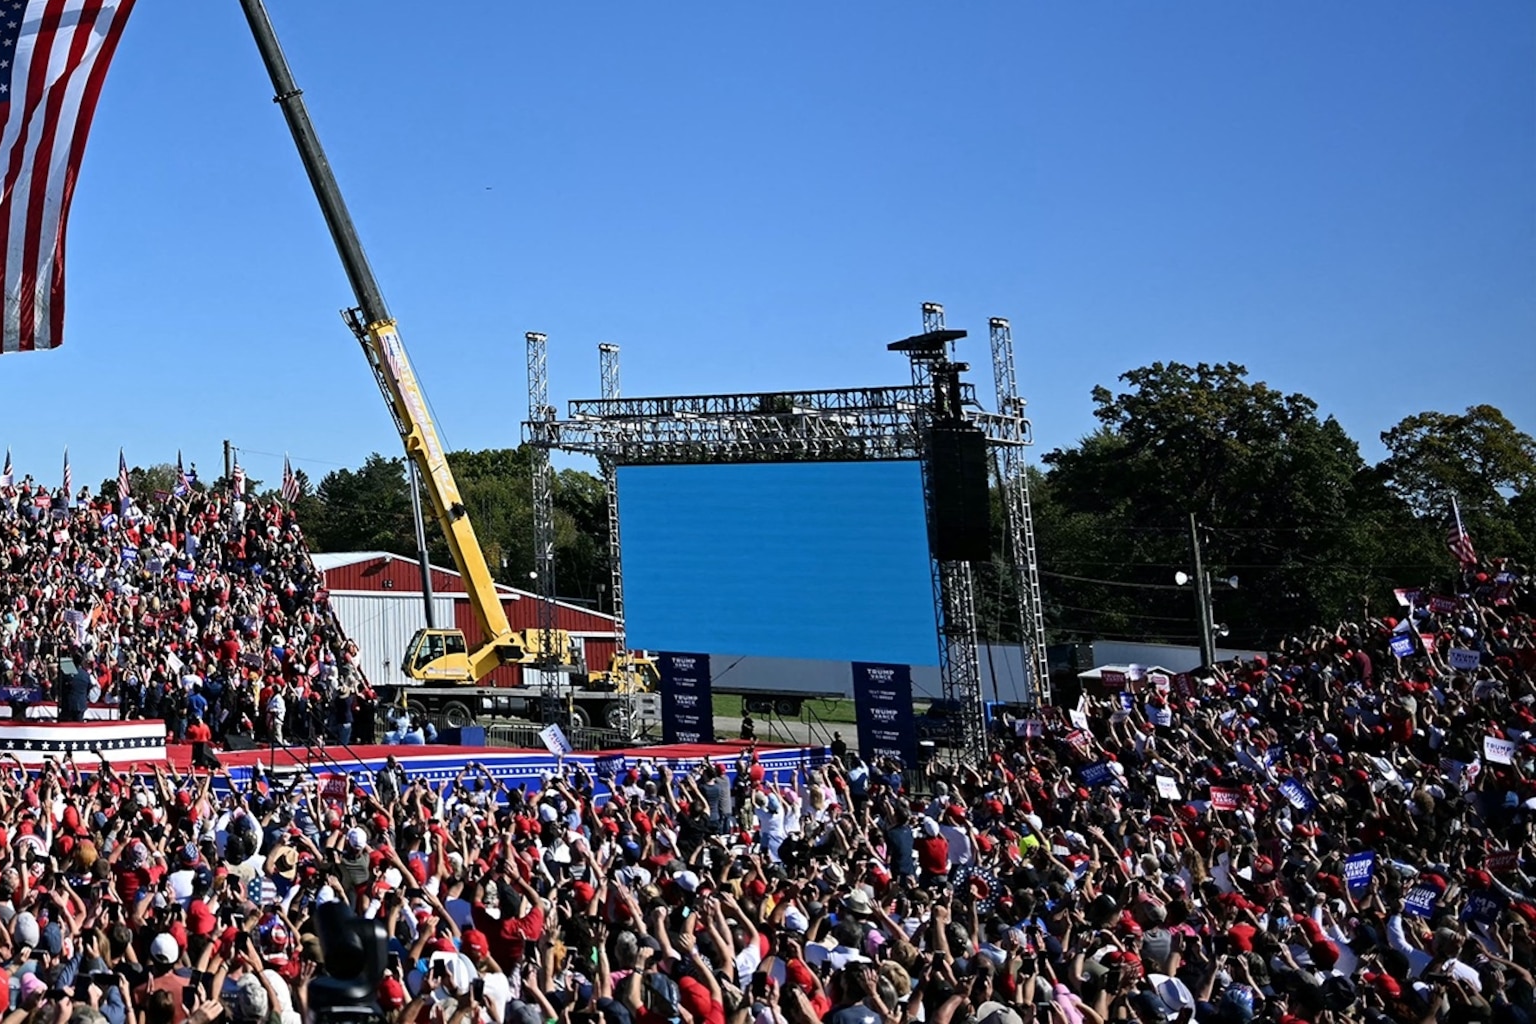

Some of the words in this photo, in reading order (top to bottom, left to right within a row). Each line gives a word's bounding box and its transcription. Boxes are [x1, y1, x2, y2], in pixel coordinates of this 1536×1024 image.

[1452, 652, 1478, 660] TRUMP
[675, 731, 700, 739] TRUMP
[551, 728, 568, 753] TRUMP
[1486, 742, 1512, 751] TRUMP
[872, 748, 901, 756] TRUMP
[595, 758, 625, 769] TRUMP
[1213, 792, 1241, 800] TRUMP
[1345, 859, 1372, 871] TRUMP
[1346, 867, 1368, 877] VANCE
